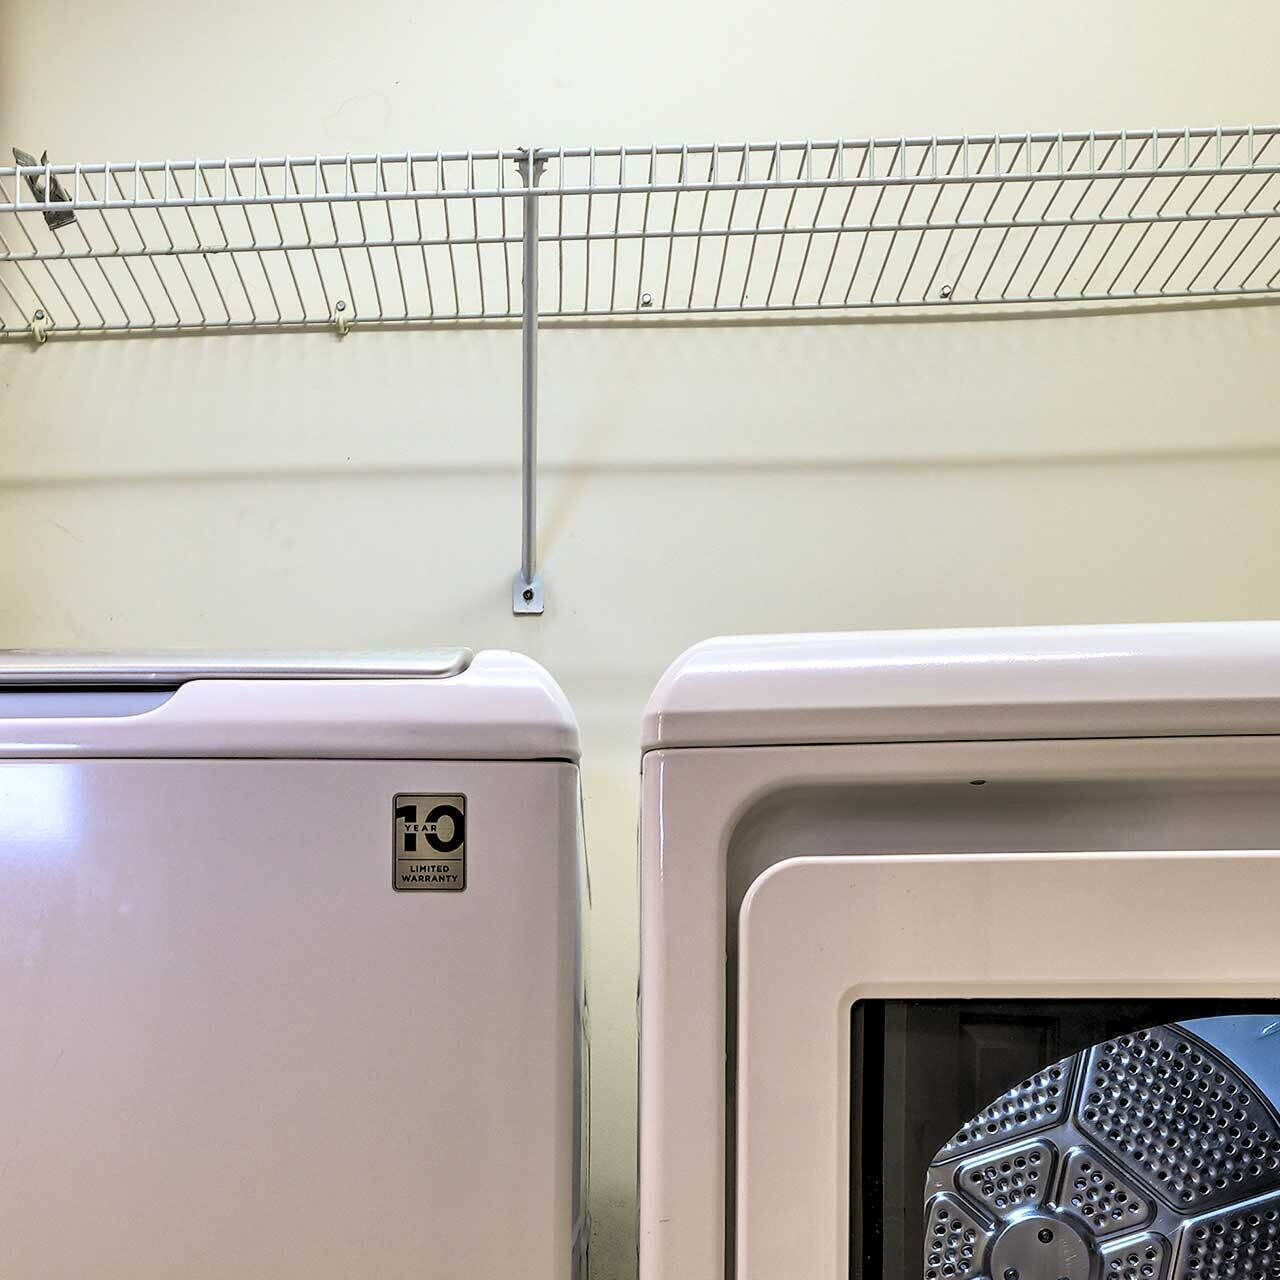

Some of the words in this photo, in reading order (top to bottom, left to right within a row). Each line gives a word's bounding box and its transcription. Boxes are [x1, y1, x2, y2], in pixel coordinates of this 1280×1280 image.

[395, 805, 465, 852] 10
[404, 824, 437, 832] YEAR
[410, 865, 450, 873] LIMITED
